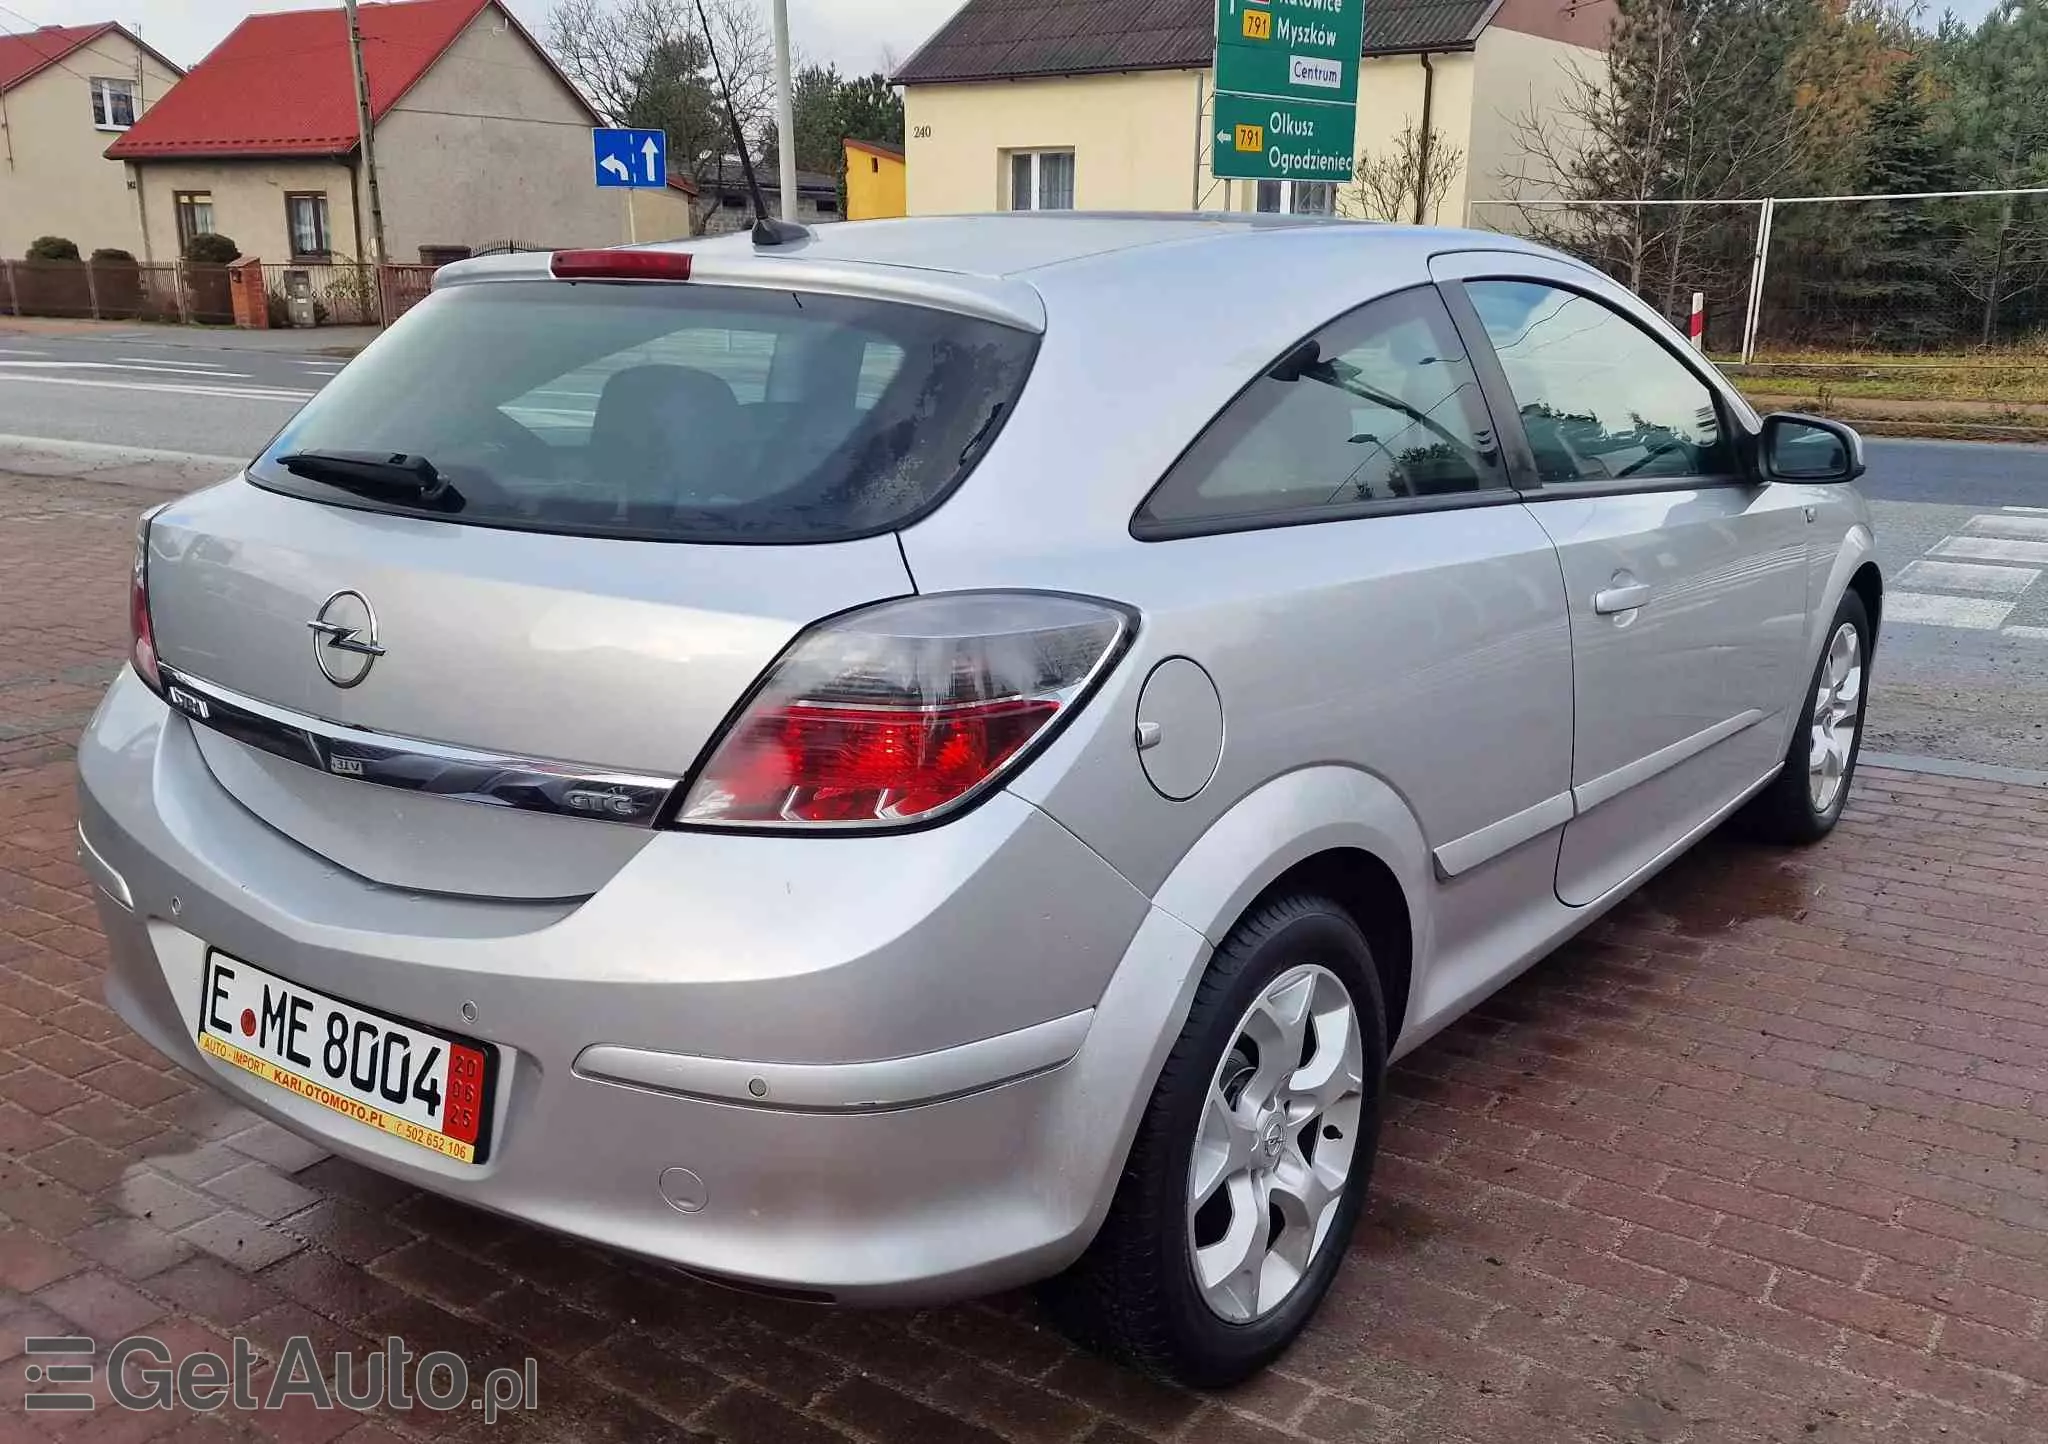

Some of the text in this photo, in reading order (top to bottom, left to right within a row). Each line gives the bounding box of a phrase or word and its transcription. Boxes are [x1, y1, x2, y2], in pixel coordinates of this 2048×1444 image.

[1247, 15, 1337, 48] 791 Myszków
[1294, 60, 1338, 83] Centrum
[912, 126, 931, 138] 240
[1270, 111, 1314, 137] Olkusz
[1240, 129, 1259, 147] 791
[1269, 146, 1352, 174] Ogrodzieniec
[209, 964, 442, 1117] E ME 8004
[204, 1037, 227, 1057] AUTO
[233, 1050, 265, 1074] IMPORT
[406, 1125, 424, 1143] 502
[426, 1133, 445, 1151] 652
[448, 1142, 466, 1159] 106
